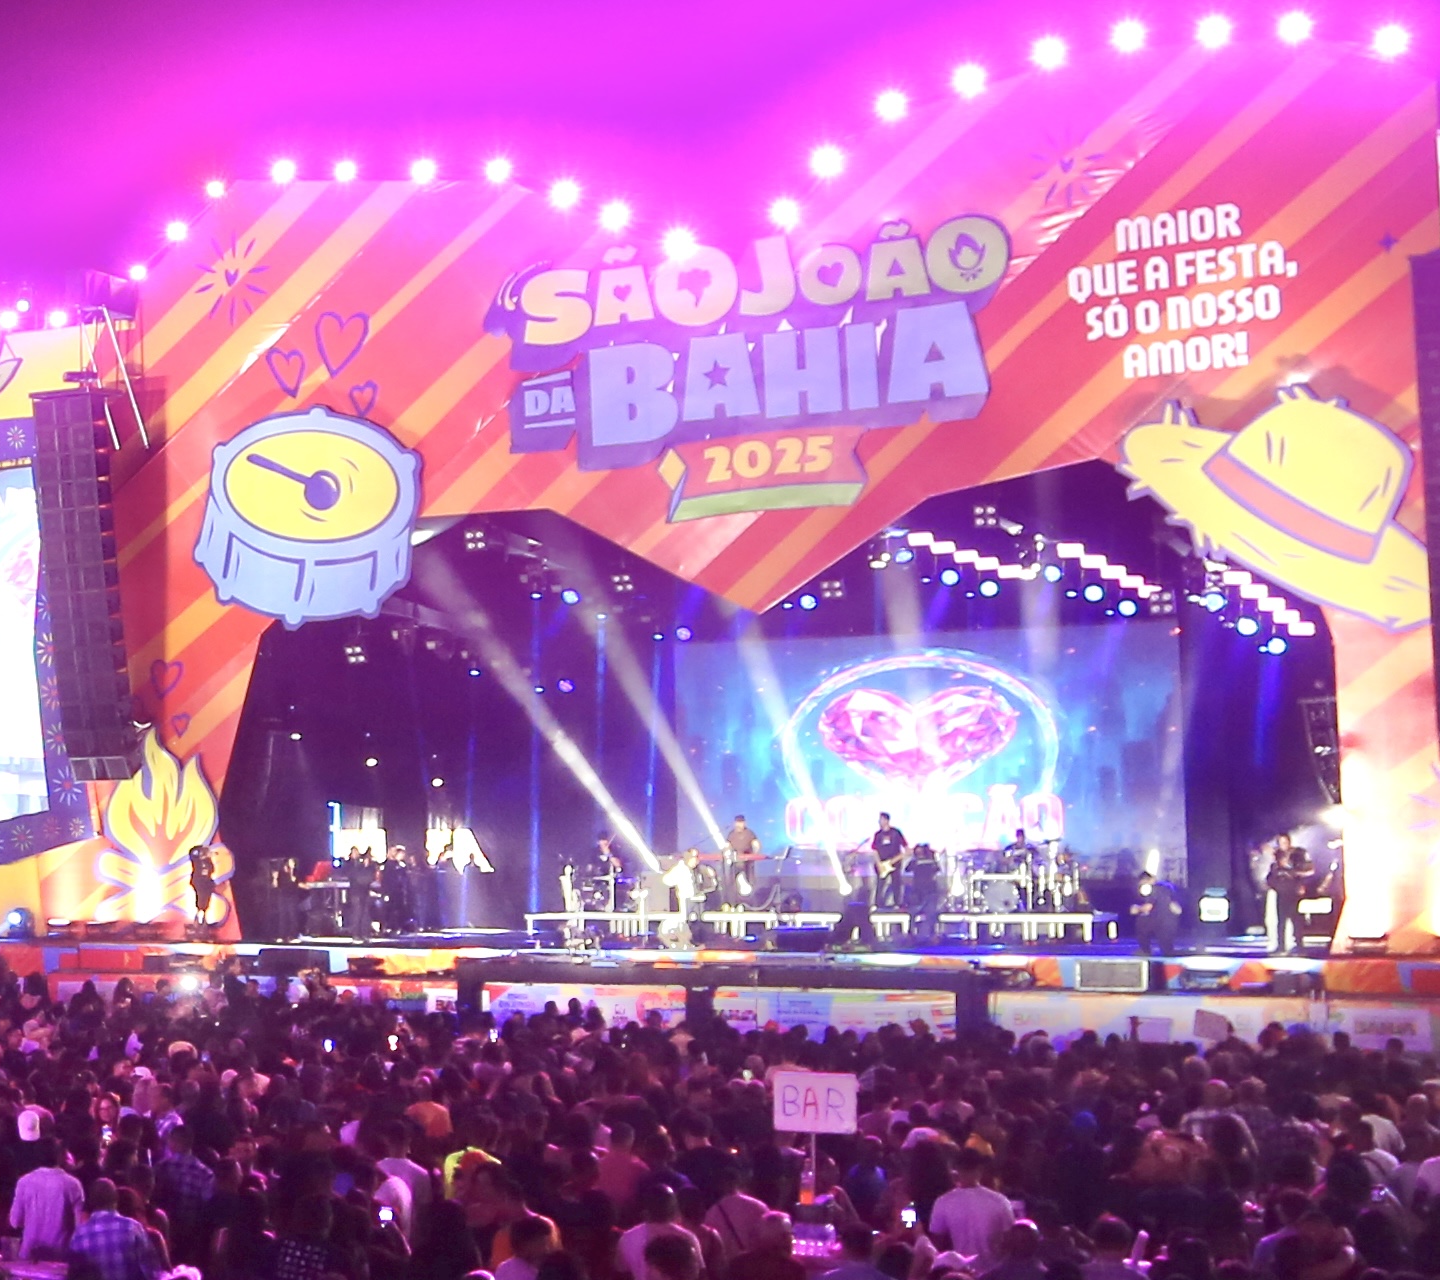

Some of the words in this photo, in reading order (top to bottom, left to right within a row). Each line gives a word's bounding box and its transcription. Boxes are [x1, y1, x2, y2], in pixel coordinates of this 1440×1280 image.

[1115, 203, 1241, 252] MAIOR
[523, 244, 738, 345] SÃO
[739, 217, 1009, 316] JOÃO
[1067, 259, 1138, 303] QUE
[1144, 256, 1169, 291] A
[1175, 240, 1298, 287] FESTA,
[1086, 297, 1129, 341] SÓ
[1135, 299, 1160, 334] O
[1166, 284, 1281, 331] NOSSO
[524, 384, 575, 417] DA
[589, 301, 989, 447] BAHIA
[1123, 331, 1249, 378] AMOR!
[704, 435, 833, 484] 2025
[781, 1084, 846, 1121] BAR
